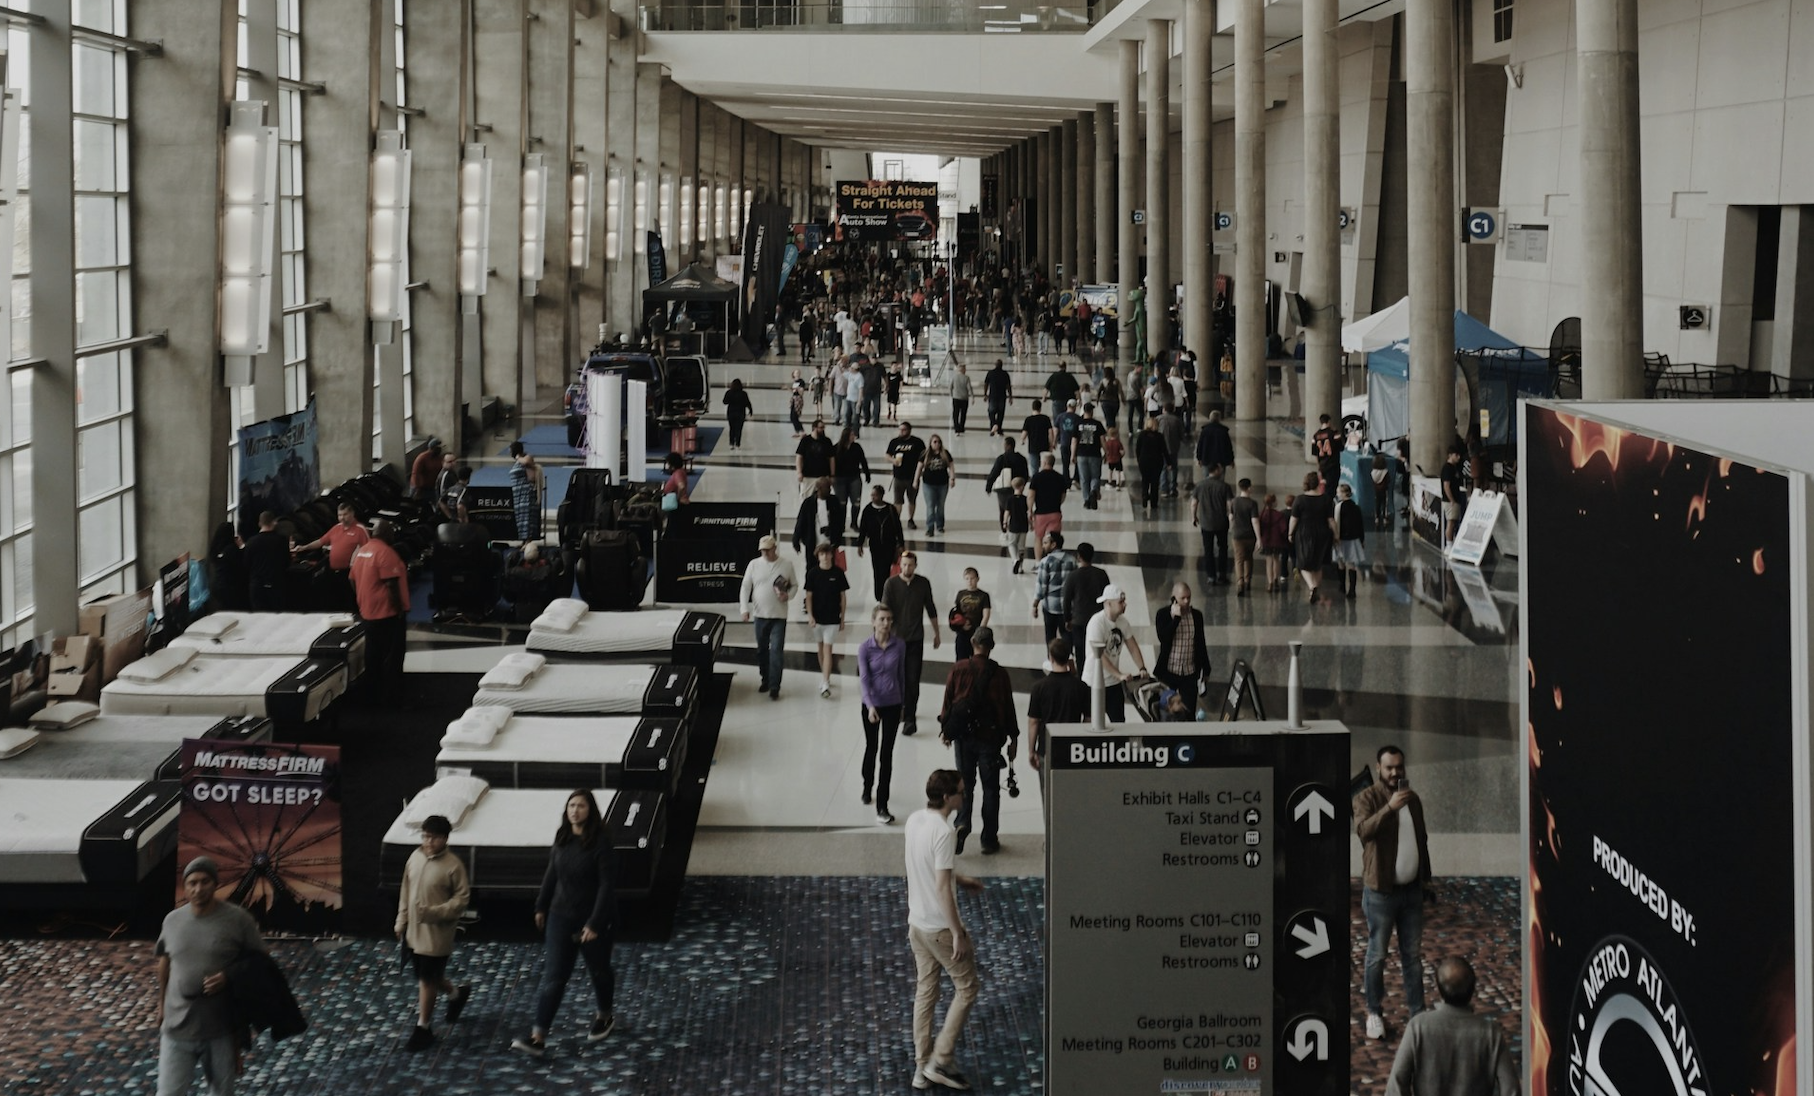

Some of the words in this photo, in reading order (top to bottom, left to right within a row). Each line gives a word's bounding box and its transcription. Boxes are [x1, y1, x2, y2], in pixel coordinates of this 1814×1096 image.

[841, 184, 893, 197] Straight
[896, 184, 936, 196] Ahead
[853, 198, 875, 209] For
[877, 198, 925, 209] Tickets
[839, 214, 864, 226] Auto
[865, 218, 887, 226] Show
[1218, 217, 1229, 226] C1
[1470, 218, 1489, 233] C1
[752, 224, 765, 272] CHEVROLET
[477, 498, 511, 507] RELAX
[1470, 510, 1493, 521] JUMP
[687, 562, 736, 572] RELIEVE
[1070, 742, 1169, 767] Building
[1177, 745, 1190, 762] C
[193, 751, 326, 774] MATTRESSFIRM
[193, 783, 241, 803] GOT
[247, 785, 323, 806] SLEEP?
[1123, 792, 1172, 805] Exhibit
[1178, 792, 1210, 804] Halls
[1217, 791, 1262, 804] C1–C4
[1166, 812, 1194, 825] Taxi
[1200, 811, 1239, 824] Stand
[1180, 833, 1239, 845] Elevator
[1162, 853, 1239, 866] Restrooms
[1593, 834, 1668, 920] PRODUCED
[1670, 898, 1697, 947] BY:
[1070, 915, 1131, 931] Meeting
[1136, 915, 1184, 928] Rooms
[1180, 934, 1238, 948] Elevator
[1162, 955, 1239, 969] Restrooms
[1137, 1016, 1194, 1031] Georgia
[1199, 1014, 1262, 1028] Ballroom
[1582, 943, 1630, 1009] METRO
[1637, 957, 1707, 1096] ATLANT
[1061, 1037, 1123, 1053] Meeting
[1128, 1037, 1177, 1050] Rooms
[1163, 1056, 1219, 1073] Building
[1225, 1056, 1237, 1070] A
[1248, 1057, 1258, 1070] B
